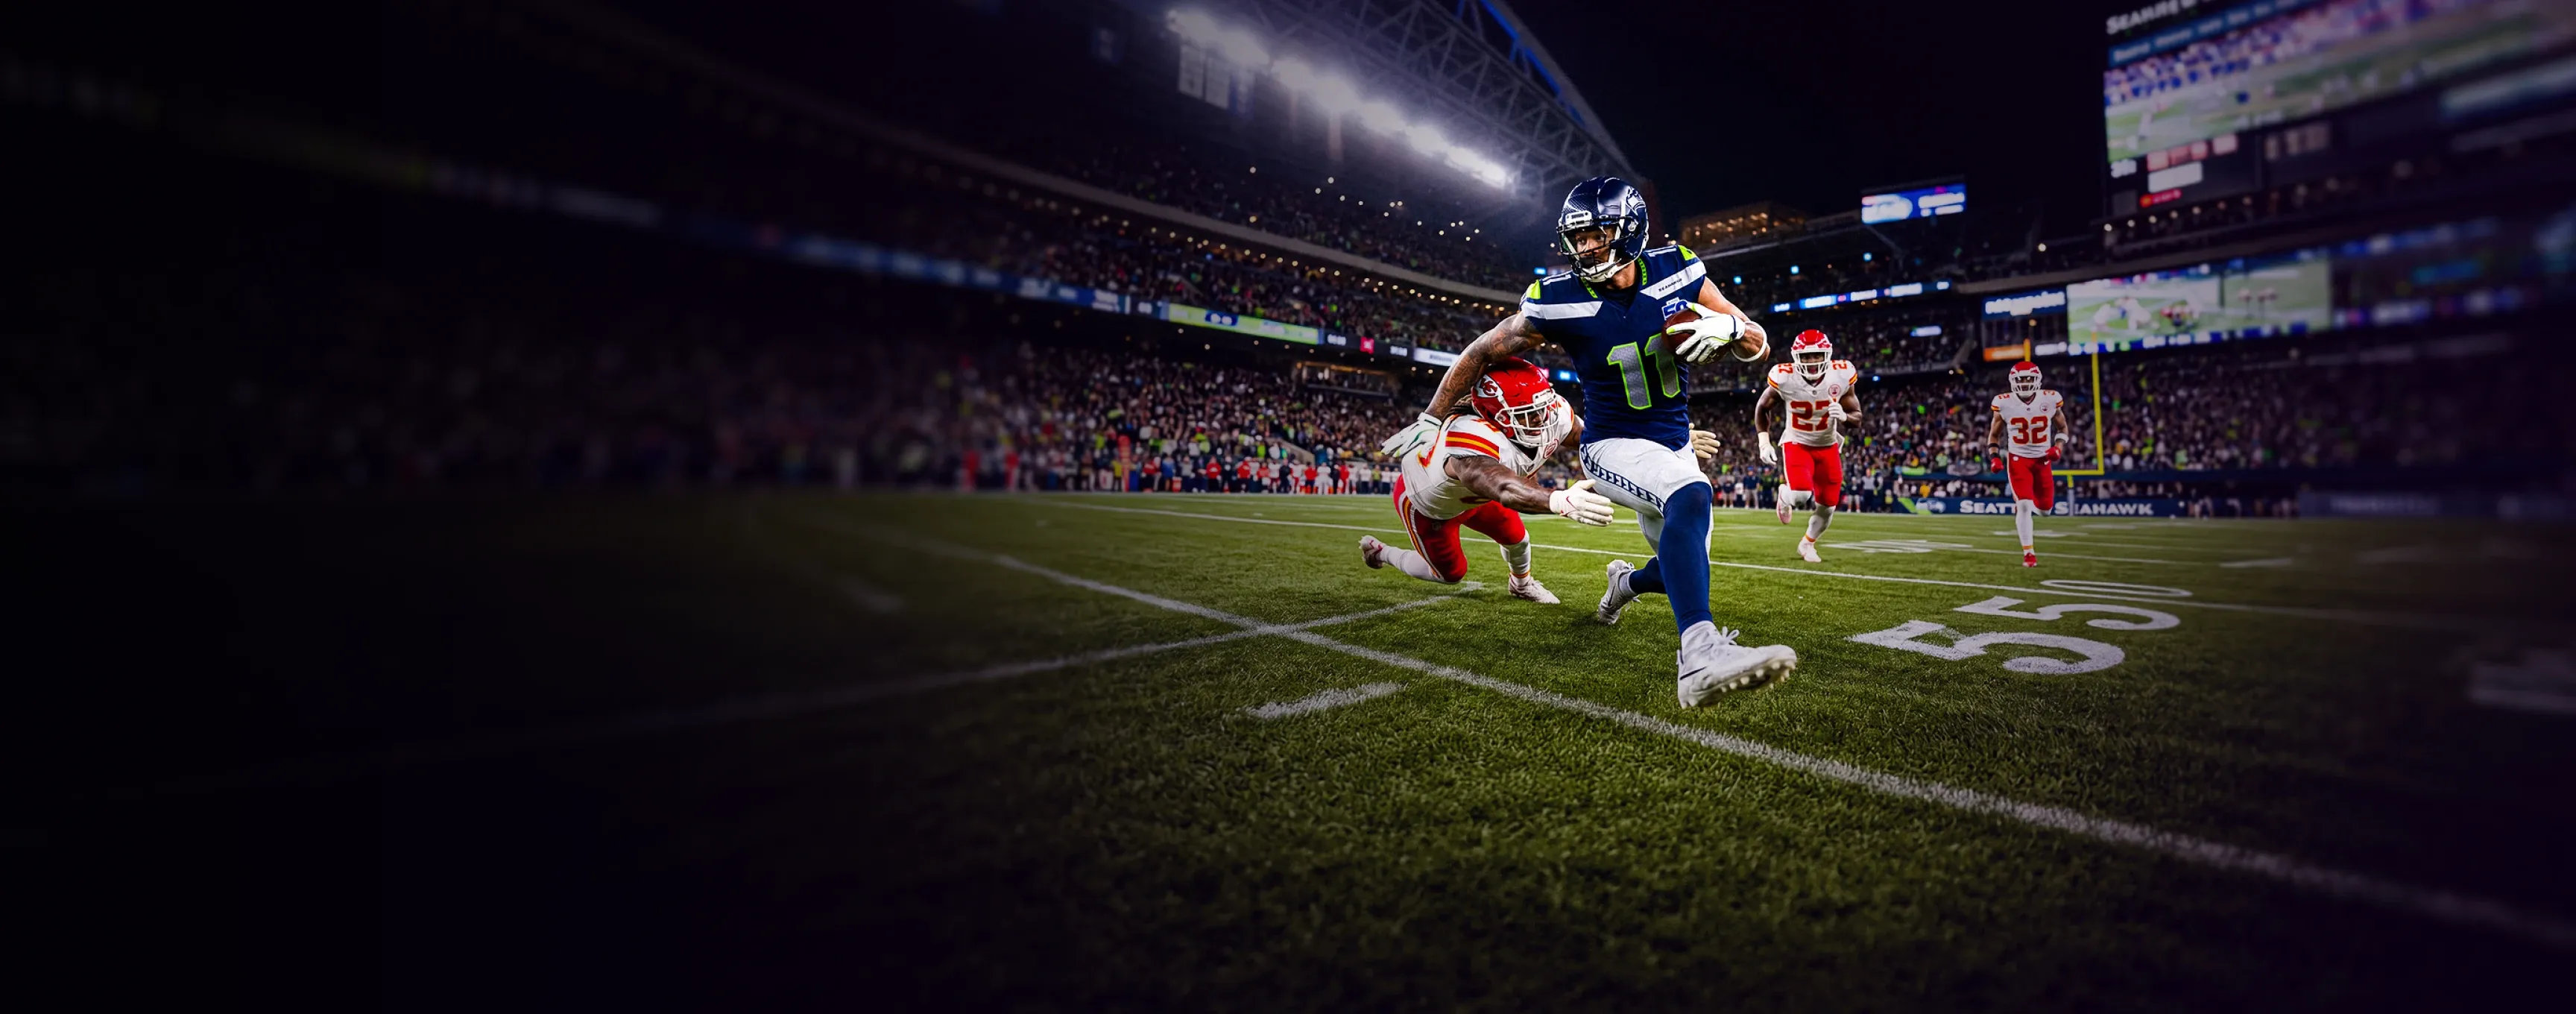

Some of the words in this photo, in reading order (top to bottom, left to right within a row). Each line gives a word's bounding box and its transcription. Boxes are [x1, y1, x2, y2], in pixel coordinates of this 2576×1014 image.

[1606, 333, 1681, 409] 11
[1790, 400, 1837, 432] 27
[2010, 415, 2048, 445] 32
[1960, 500, 2016, 514] SEATT
